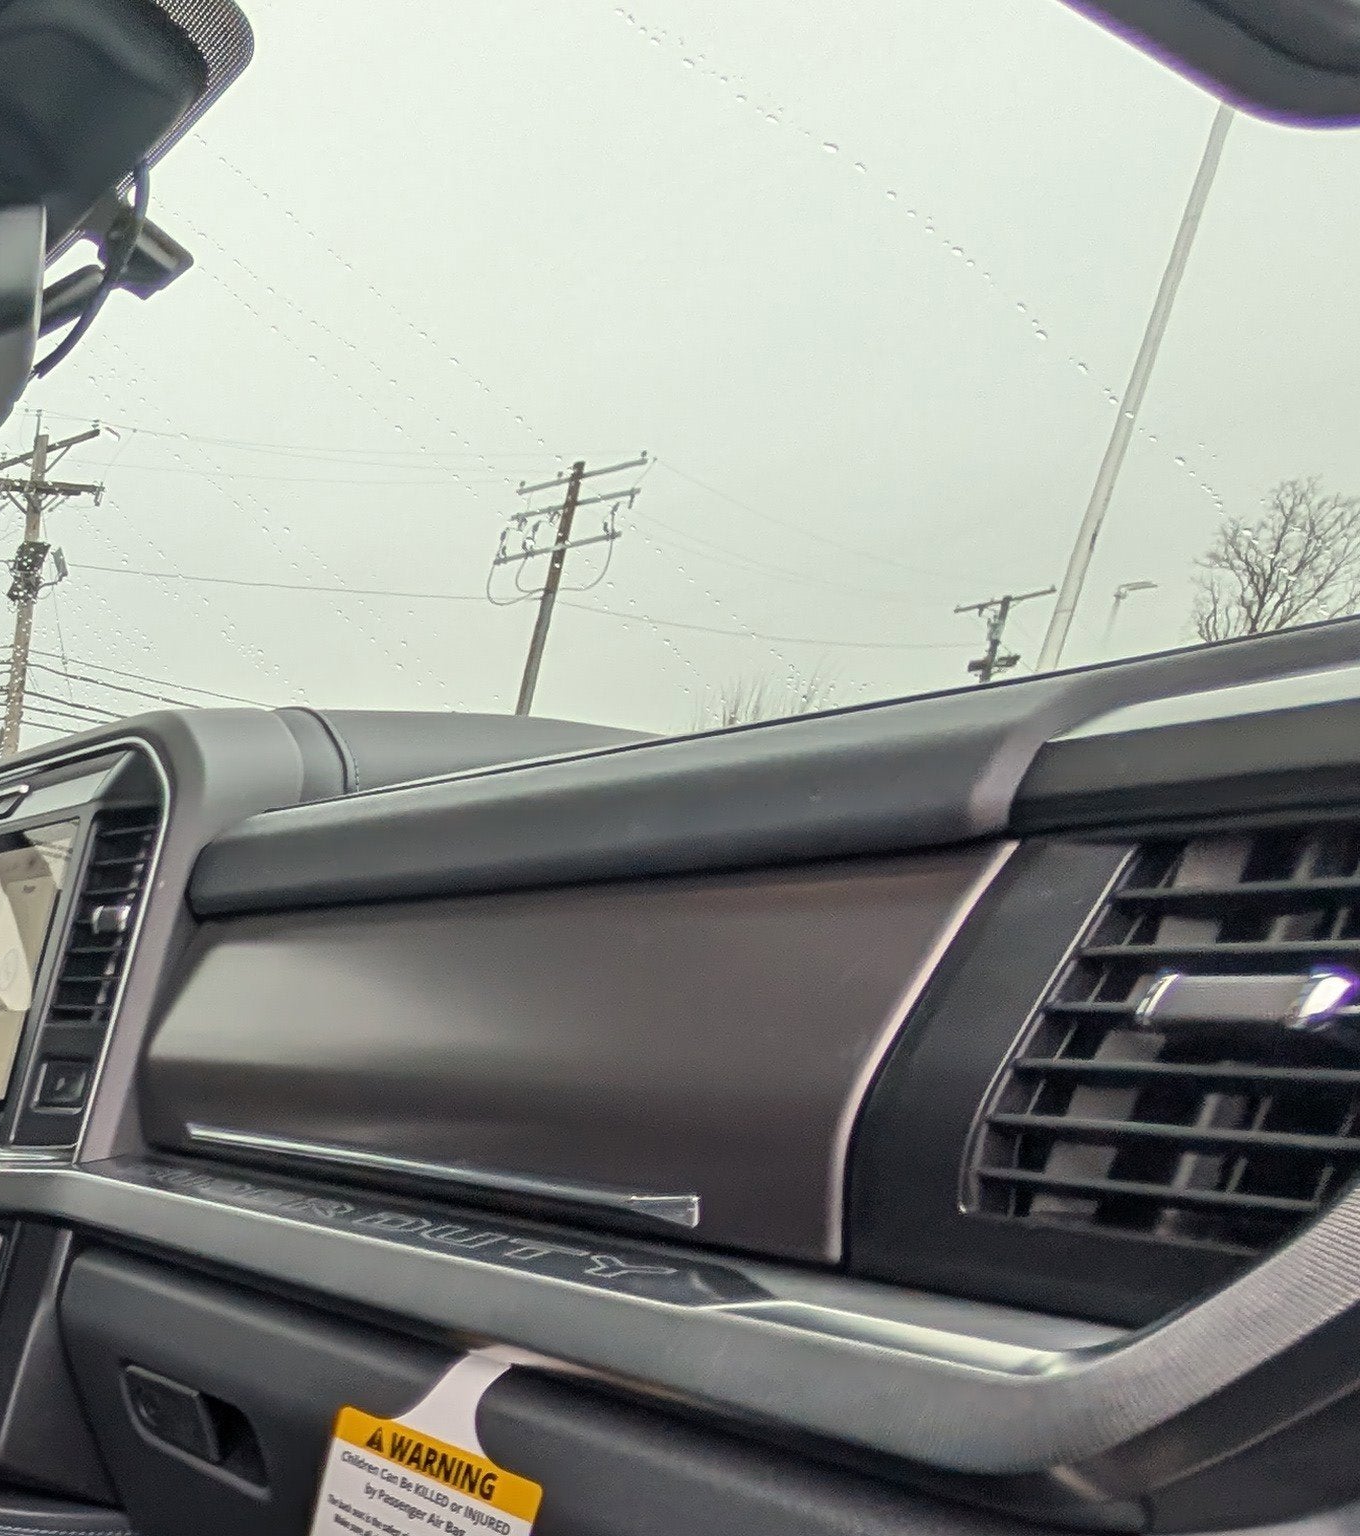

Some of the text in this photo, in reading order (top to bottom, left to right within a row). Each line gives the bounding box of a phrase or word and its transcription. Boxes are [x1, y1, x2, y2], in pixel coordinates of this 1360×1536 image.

[351, 1210, 679, 1279] DUTY
[340, 1450, 511, 1536] Children Can Be KILLED or INJURED
[389, 1432, 499, 1501] WARNING
[363, 1481, 378, 1500] by
[378, 1488, 427, 1520] Passenger
[427, 1512, 444, 1529] Air
